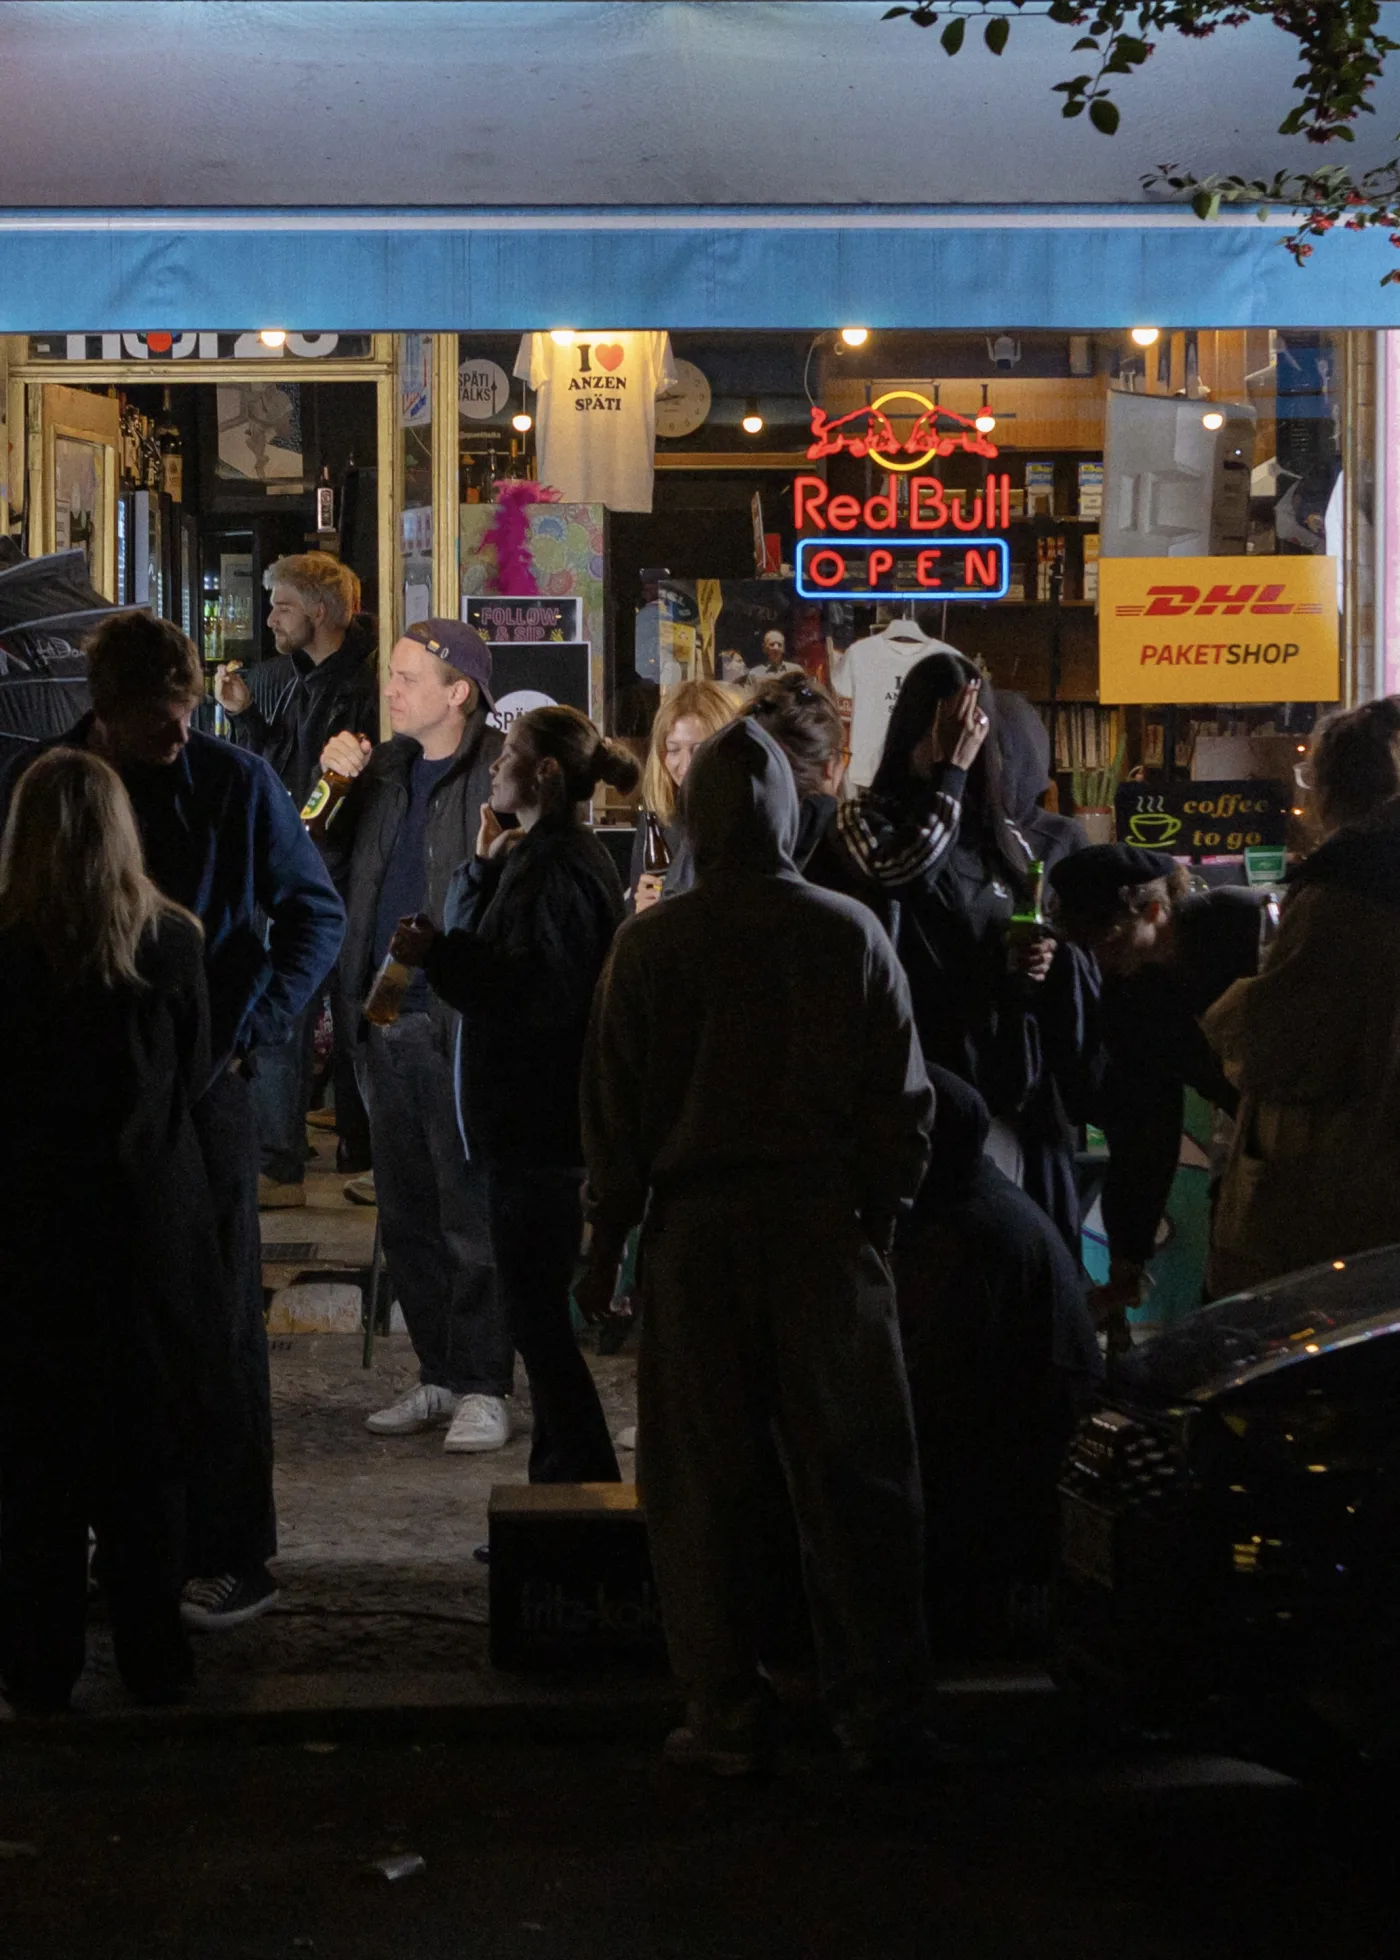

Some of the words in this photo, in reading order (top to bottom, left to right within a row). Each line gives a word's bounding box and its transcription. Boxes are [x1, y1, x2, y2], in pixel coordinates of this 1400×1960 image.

[577, 344, 592, 373] I
[568, 376, 627, 391] ANZEN
[575, 393, 622, 412] SPÄTI
[794, 473, 898, 531] Red
[909, 473, 1010, 531] Bull
[809, 549, 998, 587] OPEN
[1143, 584, 1295, 616] DHL
[480, 607, 560, 626] FOLLOW
[514, 626, 546, 642] SIP
[1140, 643, 1300, 666] PAKETSHOP
[1183, 794, 1269, 818] coffee
[1192, 830, 1221, 847] to
[1226, 831, 1262, 850] go
